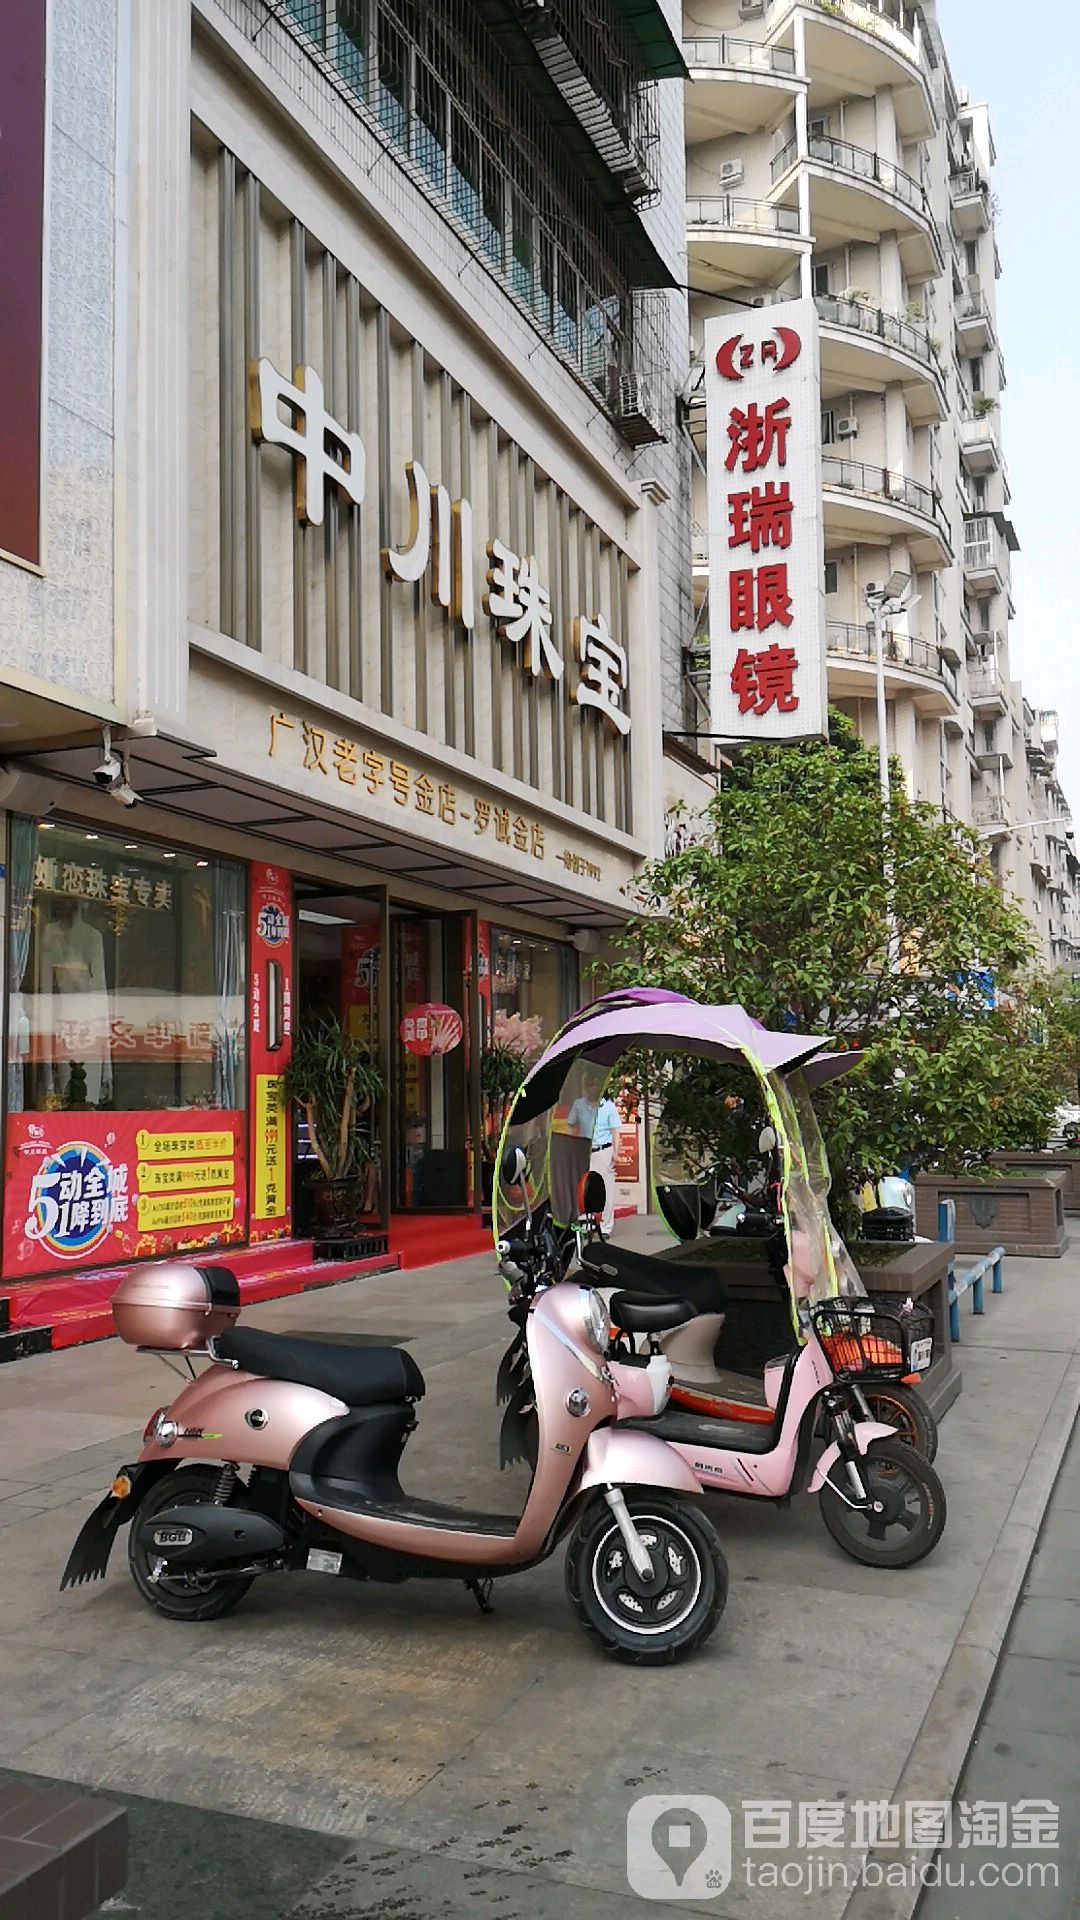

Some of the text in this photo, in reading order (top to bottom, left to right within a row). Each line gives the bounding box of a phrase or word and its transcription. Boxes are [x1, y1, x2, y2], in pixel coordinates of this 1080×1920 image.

[249, 357, 632, 736] 中川珠宝
[724, 397, 799, 716] 浙瑞眼镜
